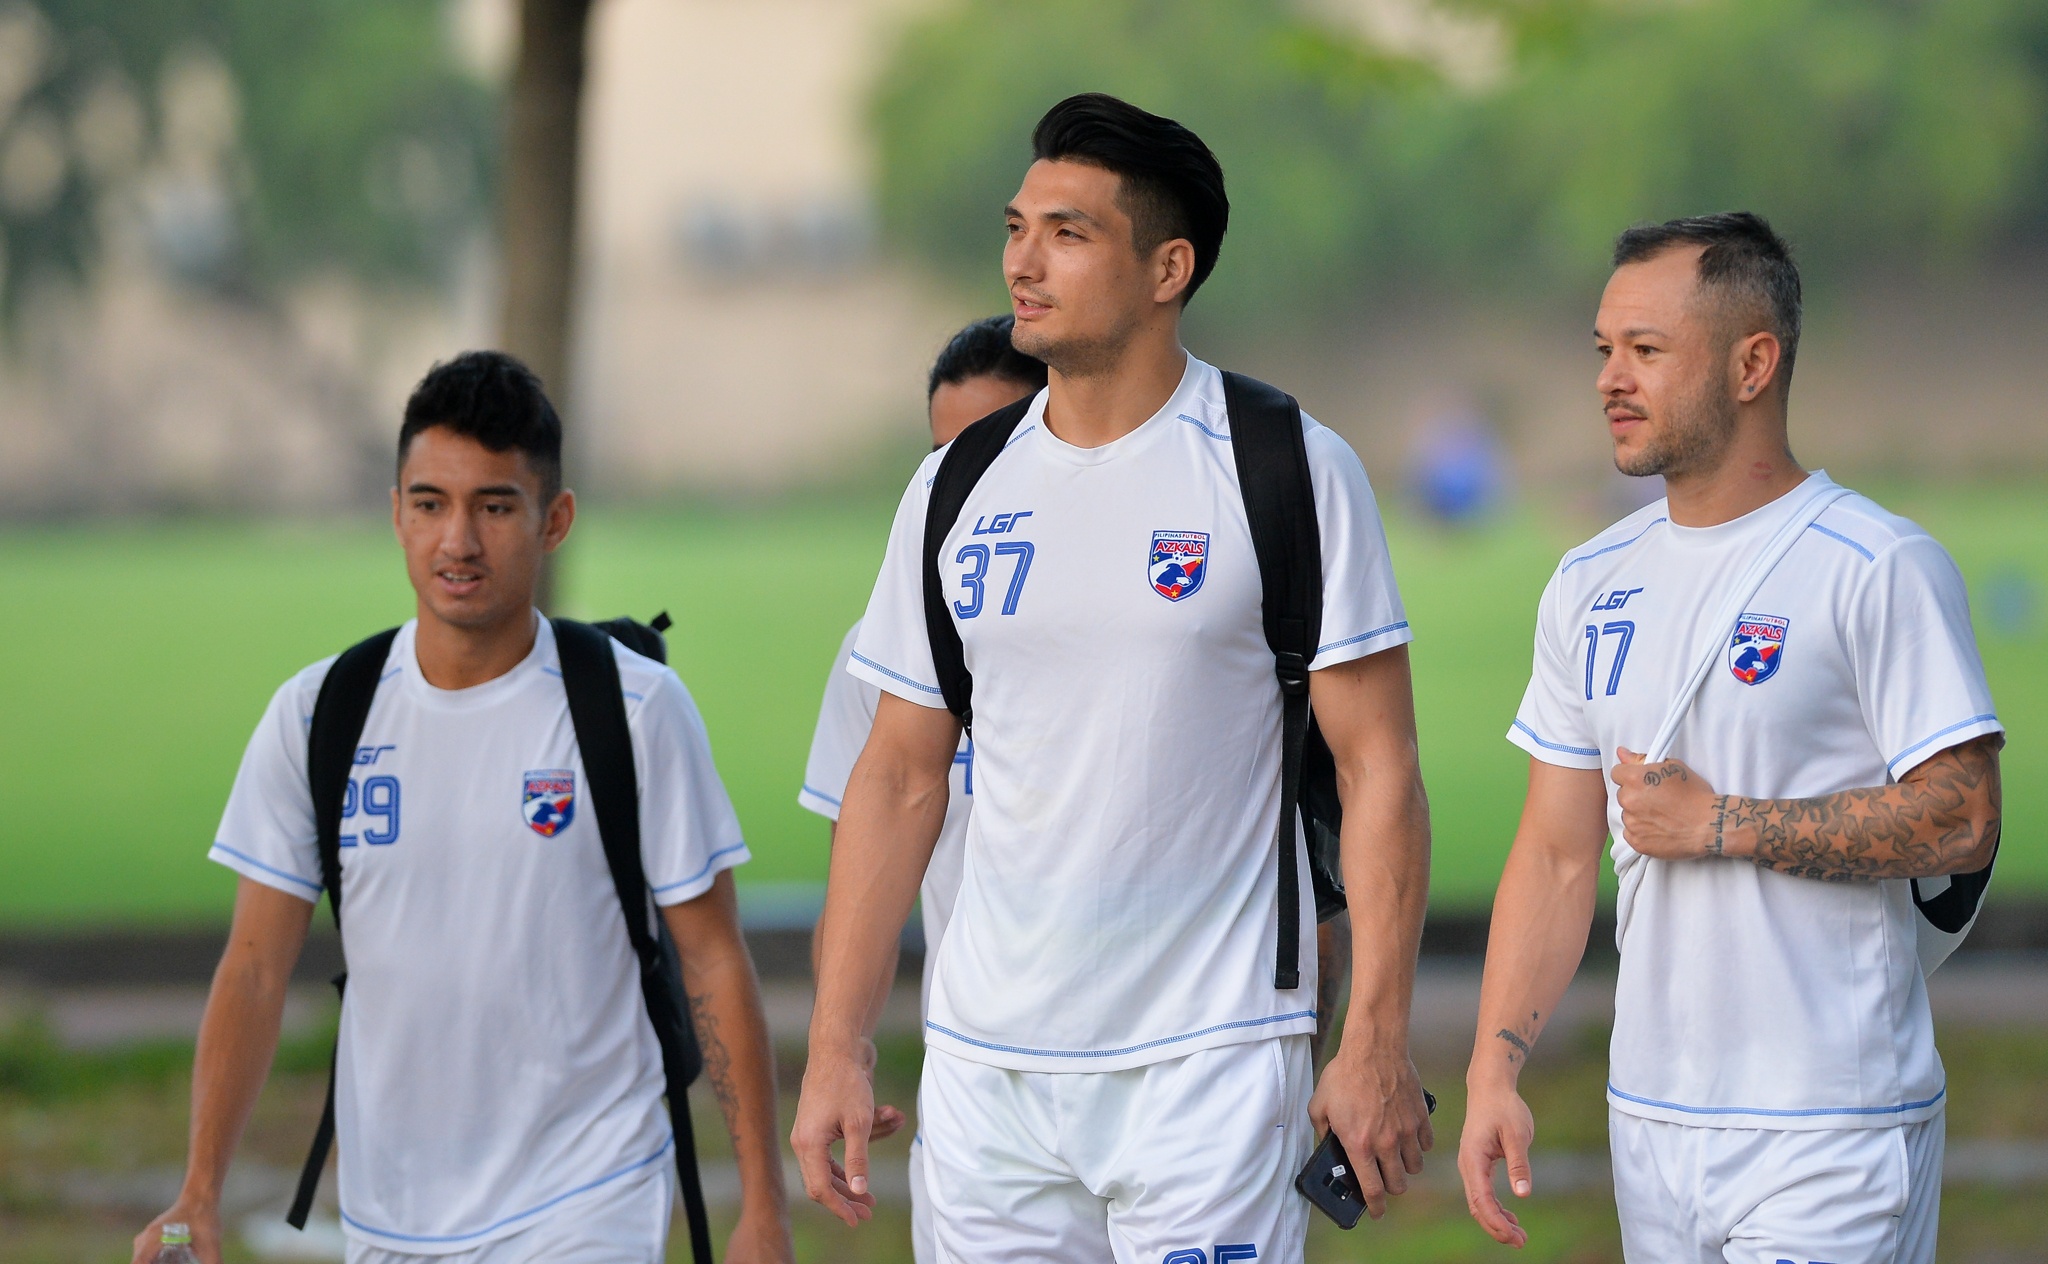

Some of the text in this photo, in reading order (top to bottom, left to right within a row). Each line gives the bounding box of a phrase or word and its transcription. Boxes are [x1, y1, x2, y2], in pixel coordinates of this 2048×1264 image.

[1155, 541, 1204, 555] AZKALS
[953, 541, 1035, 619] 37
[1737, 623, 1782, 640] AZKALS
[1585, 620, 1635, 700] 17
